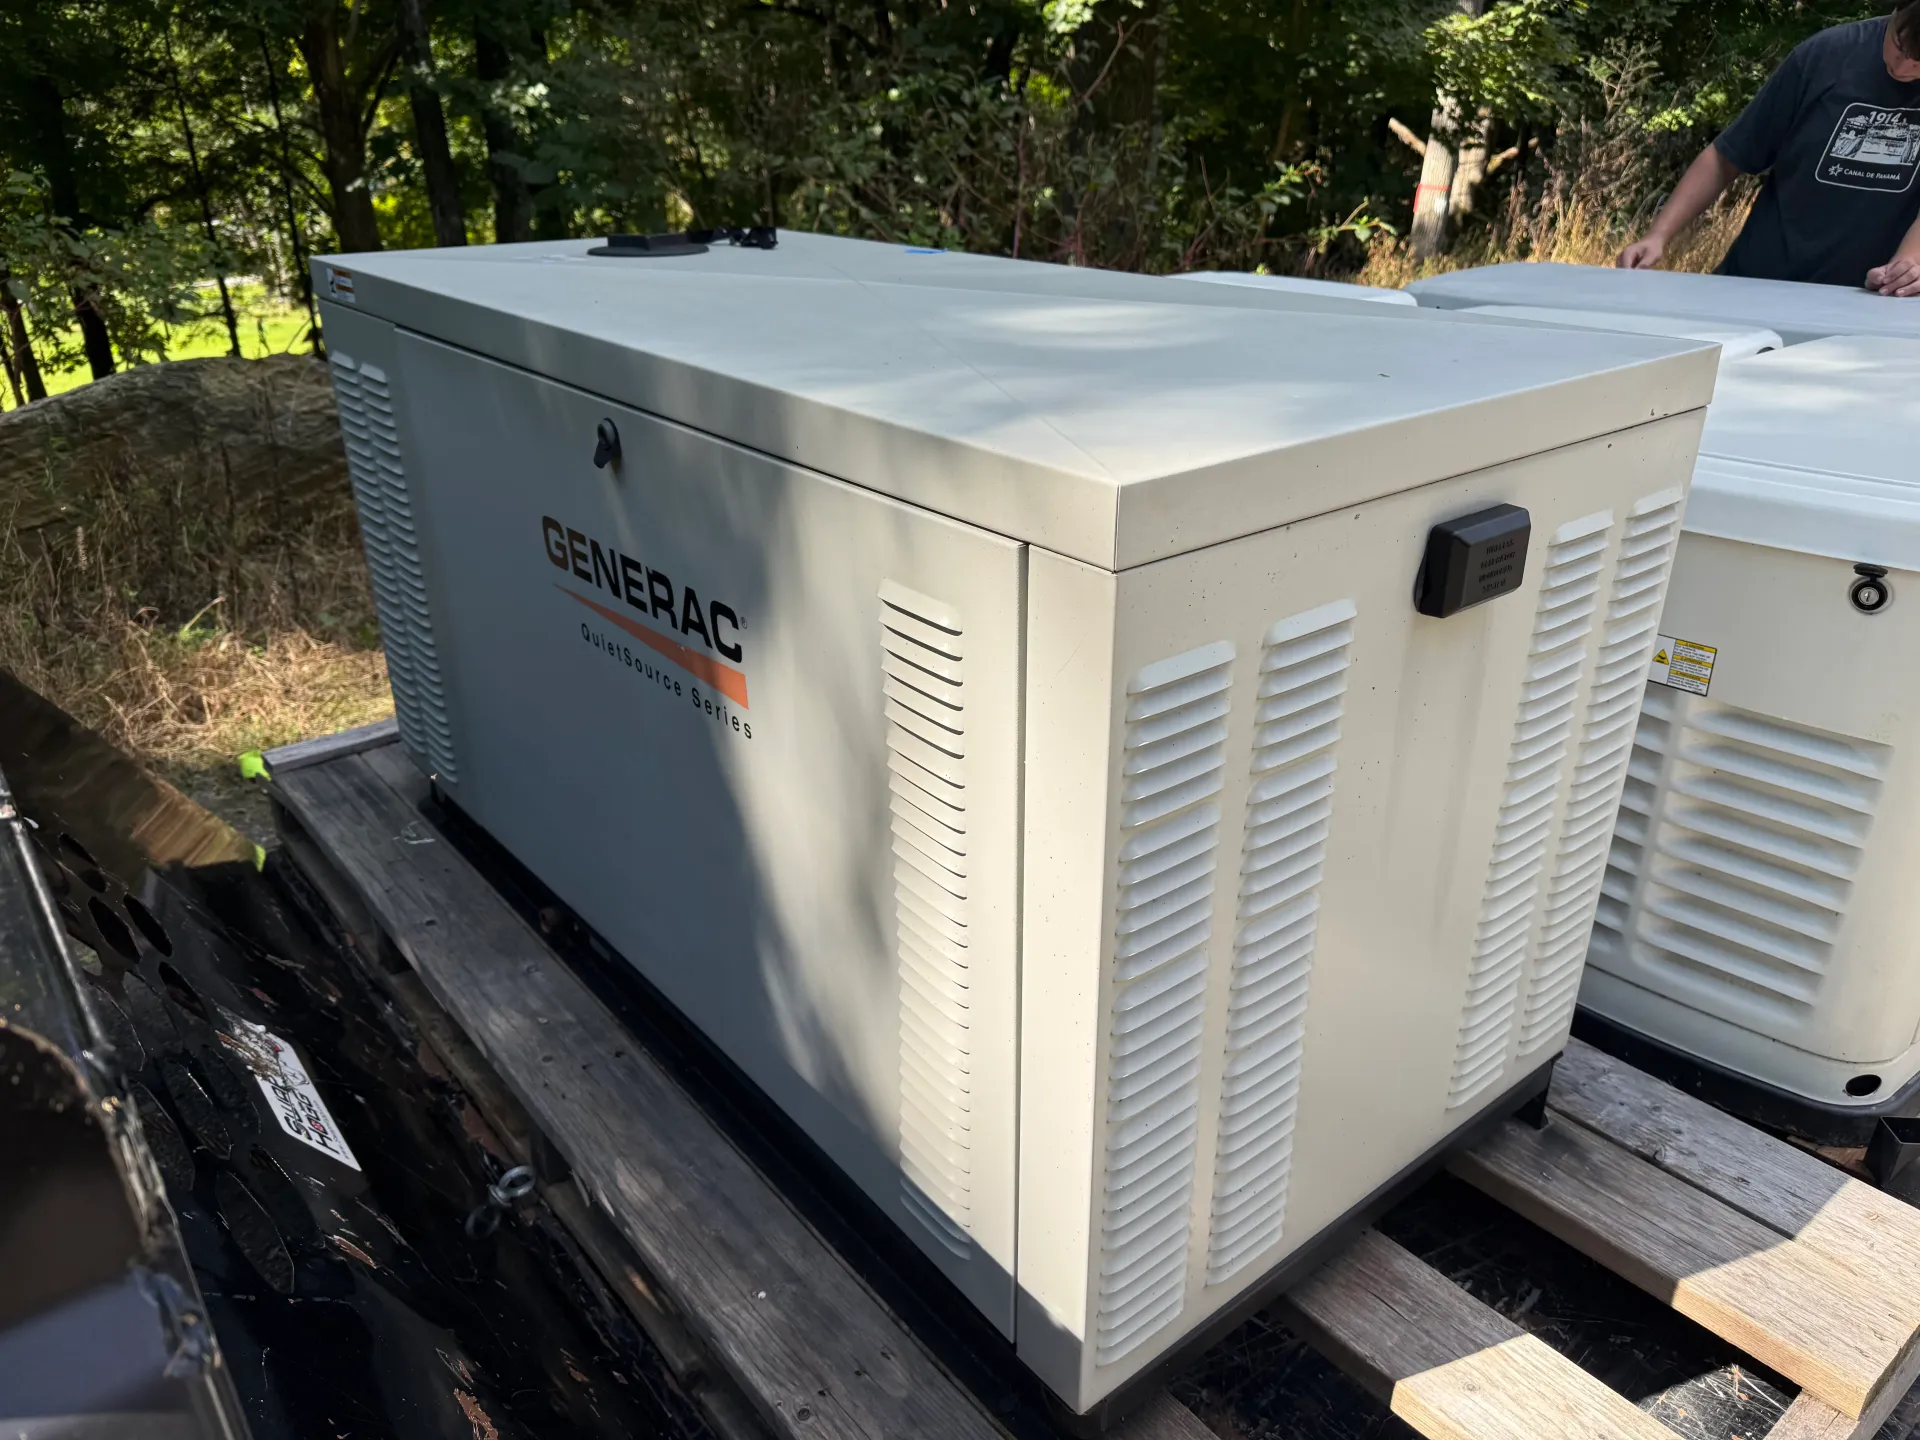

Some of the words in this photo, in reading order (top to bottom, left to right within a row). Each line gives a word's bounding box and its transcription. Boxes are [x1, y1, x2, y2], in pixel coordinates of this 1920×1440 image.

[1868, 111, 1902, 125] 1914
[1843, 168, 1865, 177] CANAL
[1866, 171, 1875, 179] DE
[1875, 172, 1901, 180] PANAMÁ
[542, 515, 742, 664] GENERAC
[581, 623, 682, 697] QuietSource
[691, 687, 752, 739] Series
